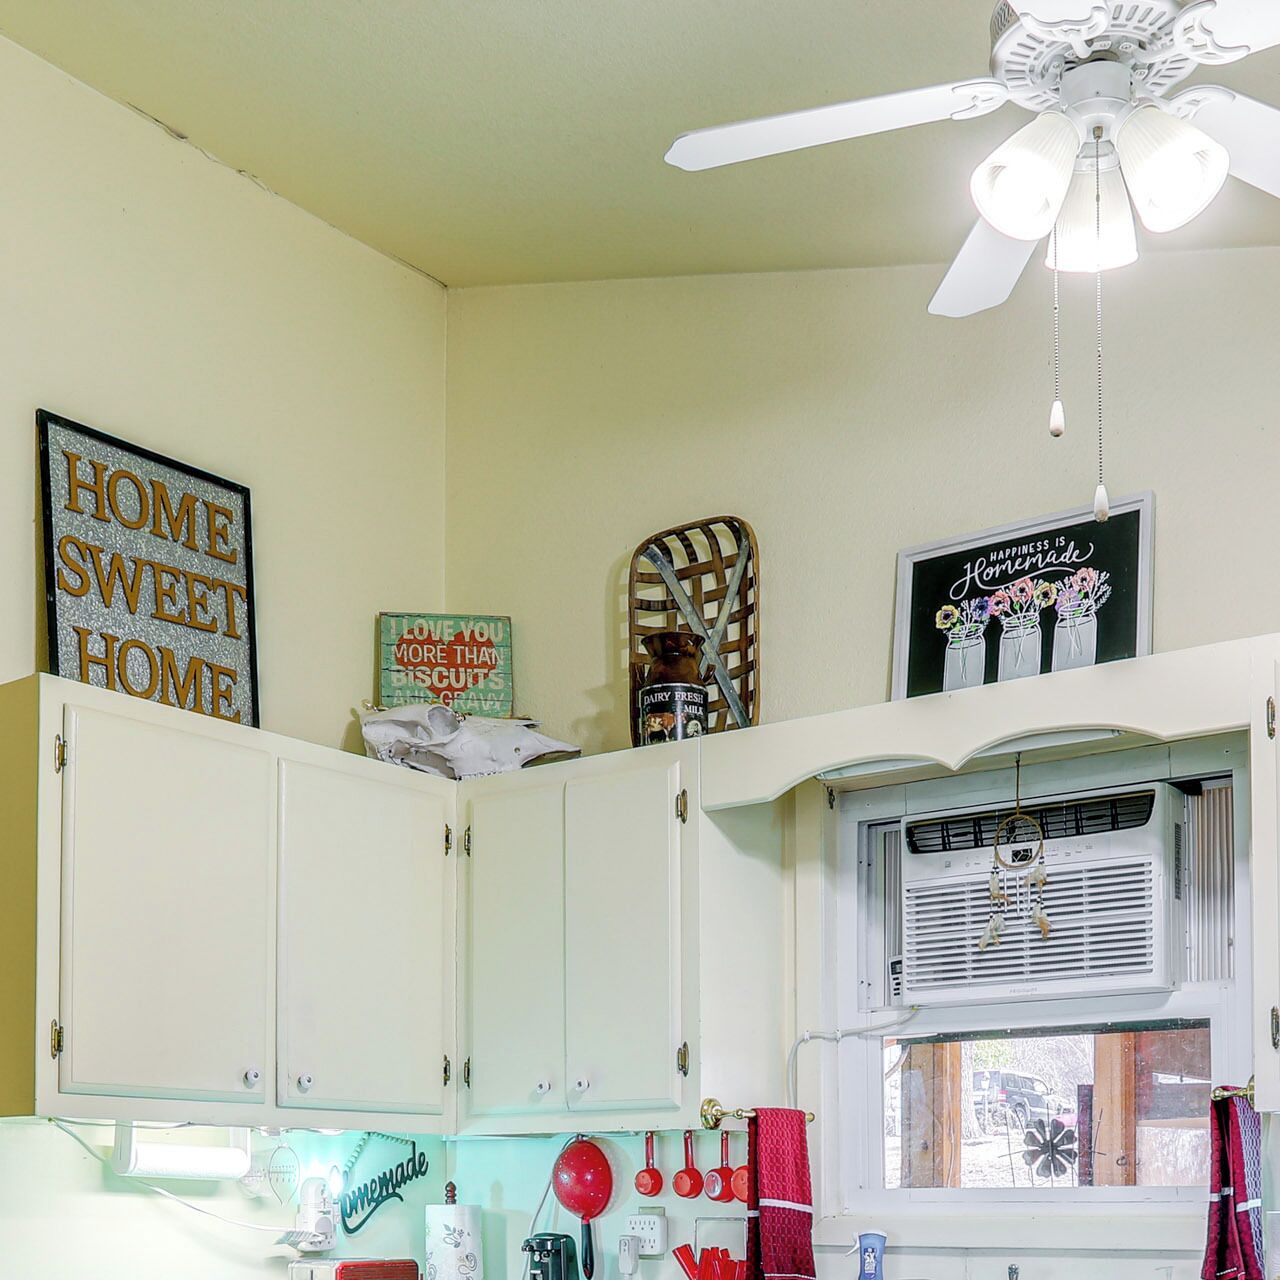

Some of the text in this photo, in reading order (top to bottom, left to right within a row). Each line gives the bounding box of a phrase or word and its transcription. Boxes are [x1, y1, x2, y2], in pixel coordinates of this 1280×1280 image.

[62, 450, 238, 565] HOME
[990, 536, 1066, 562] HAPPINESS IS
[949, 541, 1095, 600] Homemade
[57, 535, 248, 640] SWEET
[390, 618, 504, 643] I LOVE YOU
[393, 643, 504, 665] MORE THAN
[72, 626, 241, 724] HOME
[391, 665, 505, 690] BISCUITS
[440, 690, 505, 711] GRAVY
[643, 691, 704, 705] DAIRY FRESH
[684, 704, 704, 716] MILK
[340, 1140, 429, 1235] omemade
